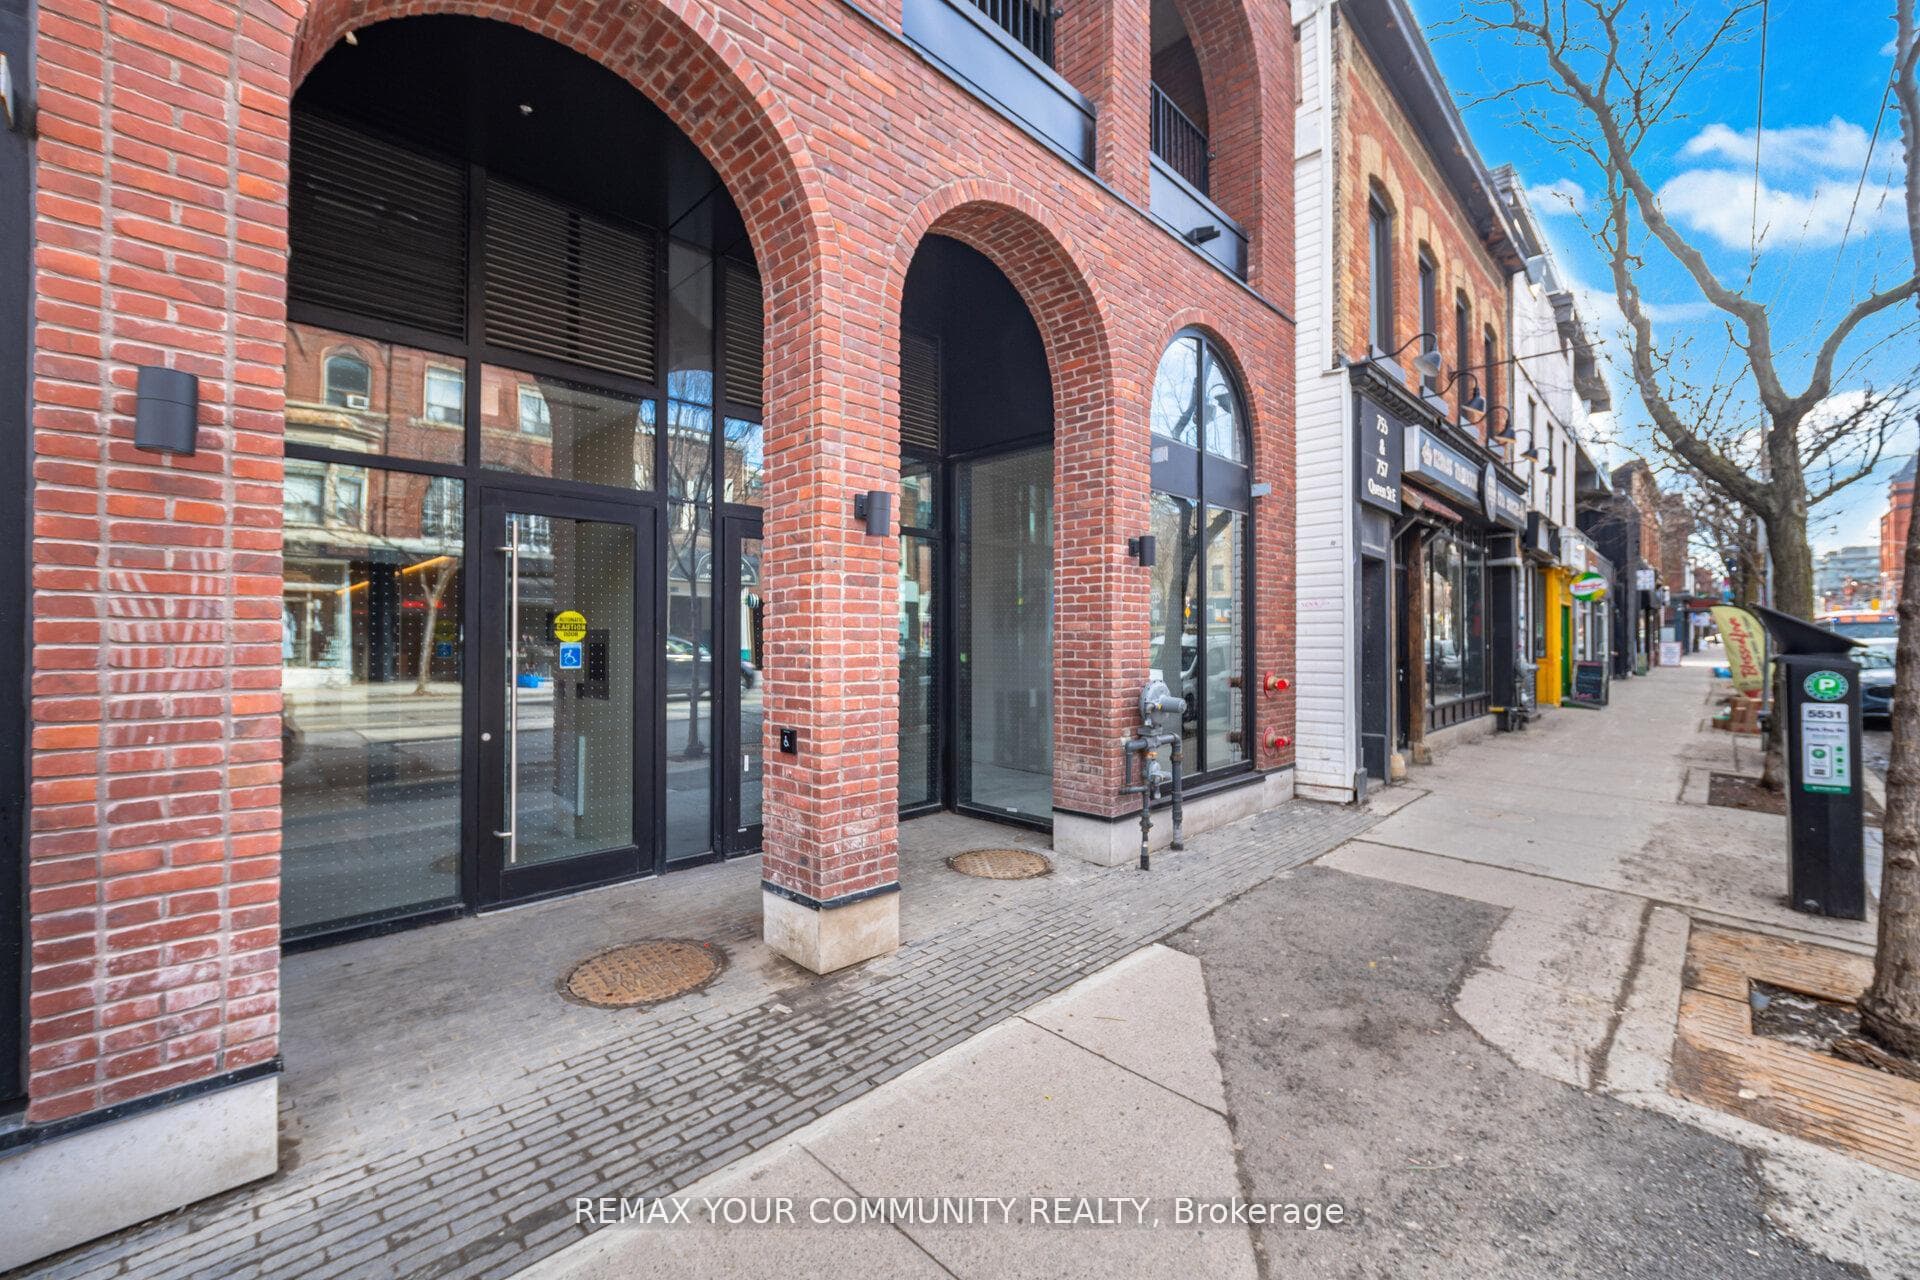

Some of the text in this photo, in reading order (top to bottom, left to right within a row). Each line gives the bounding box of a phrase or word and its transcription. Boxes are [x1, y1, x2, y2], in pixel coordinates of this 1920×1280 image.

[1379, 438, 1386, 456] &
[1377, 458, 1389, 478] 757
[1368, 478, 1386, 499] Queen
[556, 623, 586, 631] CAUTION
[1807, 709, 1842, 719] 5531
